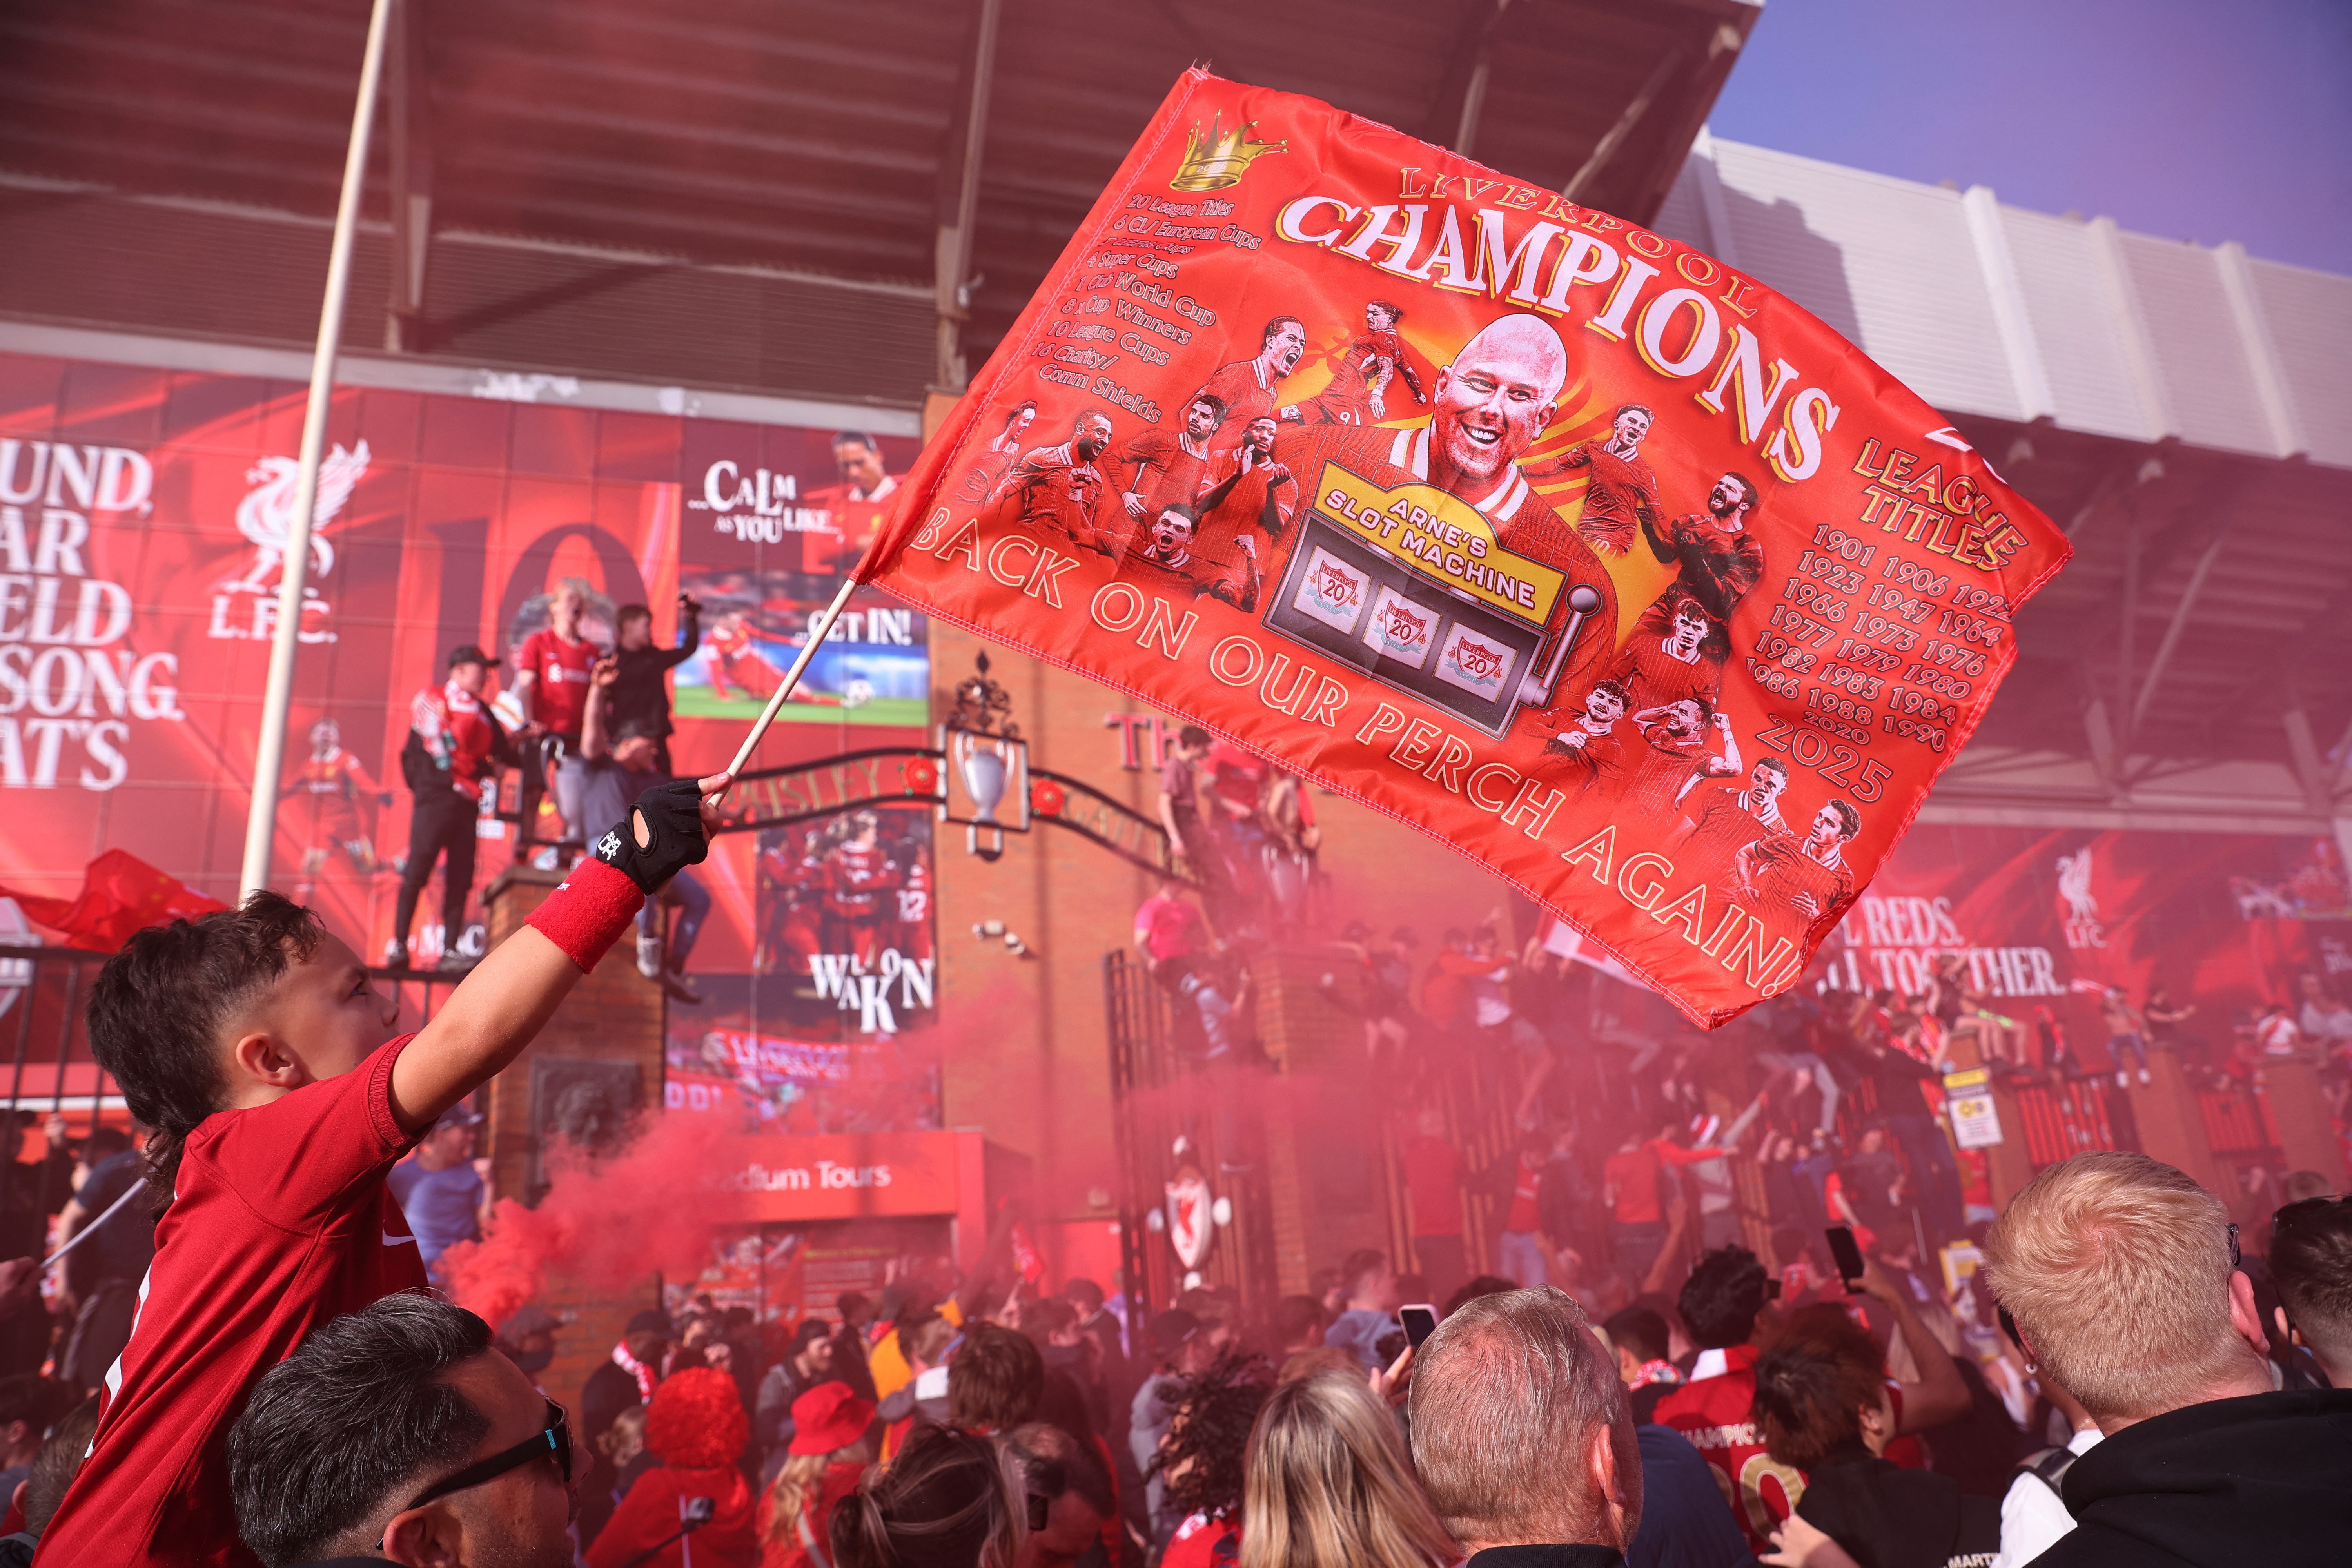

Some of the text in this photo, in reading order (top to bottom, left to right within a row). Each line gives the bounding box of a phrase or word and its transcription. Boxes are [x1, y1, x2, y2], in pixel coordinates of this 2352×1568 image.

[1127, 194, 1235, 217] 20 League Titles
[1113, 215, 1129, 230] 6
[1155, 221, 1218, 241] European
[1220, 224, 1262, 250] Cups
[1155, 242, 1196, 254] Cups
[1399, 167, 1758, 318] LIVERPOOL
[1087, 251, 1179, 279] 4 Super Cups
[1062, 295, 1192, 345] 8 x Cup Winners
[1076, 276, 1087, 291] 1
[1115, 272, 1173, 309] World
[1175, 296, 1216, 327] Cup
[1031, 341, 1119, 370] 16 Charity/
[1047, 320, 1170, 366] 10 League Cups
[1276, 196, 1841, 483] CHAMPIONS
[1039, 363, 1161, 423] Comm Shields
[1853, 438, 2028, 554] LEAGUE
[733, 514, 783, 544] YOU
[1326, 488, 1536, 610] SLOT MACHINE
[1388, 498, 1488, 558] ARNE'S
[1860, 485, 2009, 571] TITLES
[1322, 566, 1354, 588] LIVERPOOL
[1814, 525, 1876, 567] 1901
[1883, 557, 1950, 597] 1906
[1323, 579, 1345, 601] 20
[1798, 552, 2003, 647] 1923 1947 1964
[867, 607, 913, 646] IN!
[1388, 619, 1411, 640] 20
[1389, 606, 1421, 628] LIVERPOOL
[1784, 578, 1987, 676] 1966 1973 1976
[1461, 643, 1497, 663] LIVERPOOL
[1463, 654, 1487, 673] 20
[1770, 605, 1971, 699] 1977 1979 1980
[1747, 657, 1947, 752] 1986 1988 1990
[1755, 632, 1956, 726] 1982 1983 1984
[910, 506, 1802, 997] BACK ON OUR PERCH AGAIN!
[1105, 711, 1181, 771] Th
[1803, 711, 1869, 744] 2020
[1756, 714, 1893, 802] 2025
[896, 889, 927, 922] 12
[880, 947, 934, 1009] ON
[813, 1159, 893, 1189] Tours
